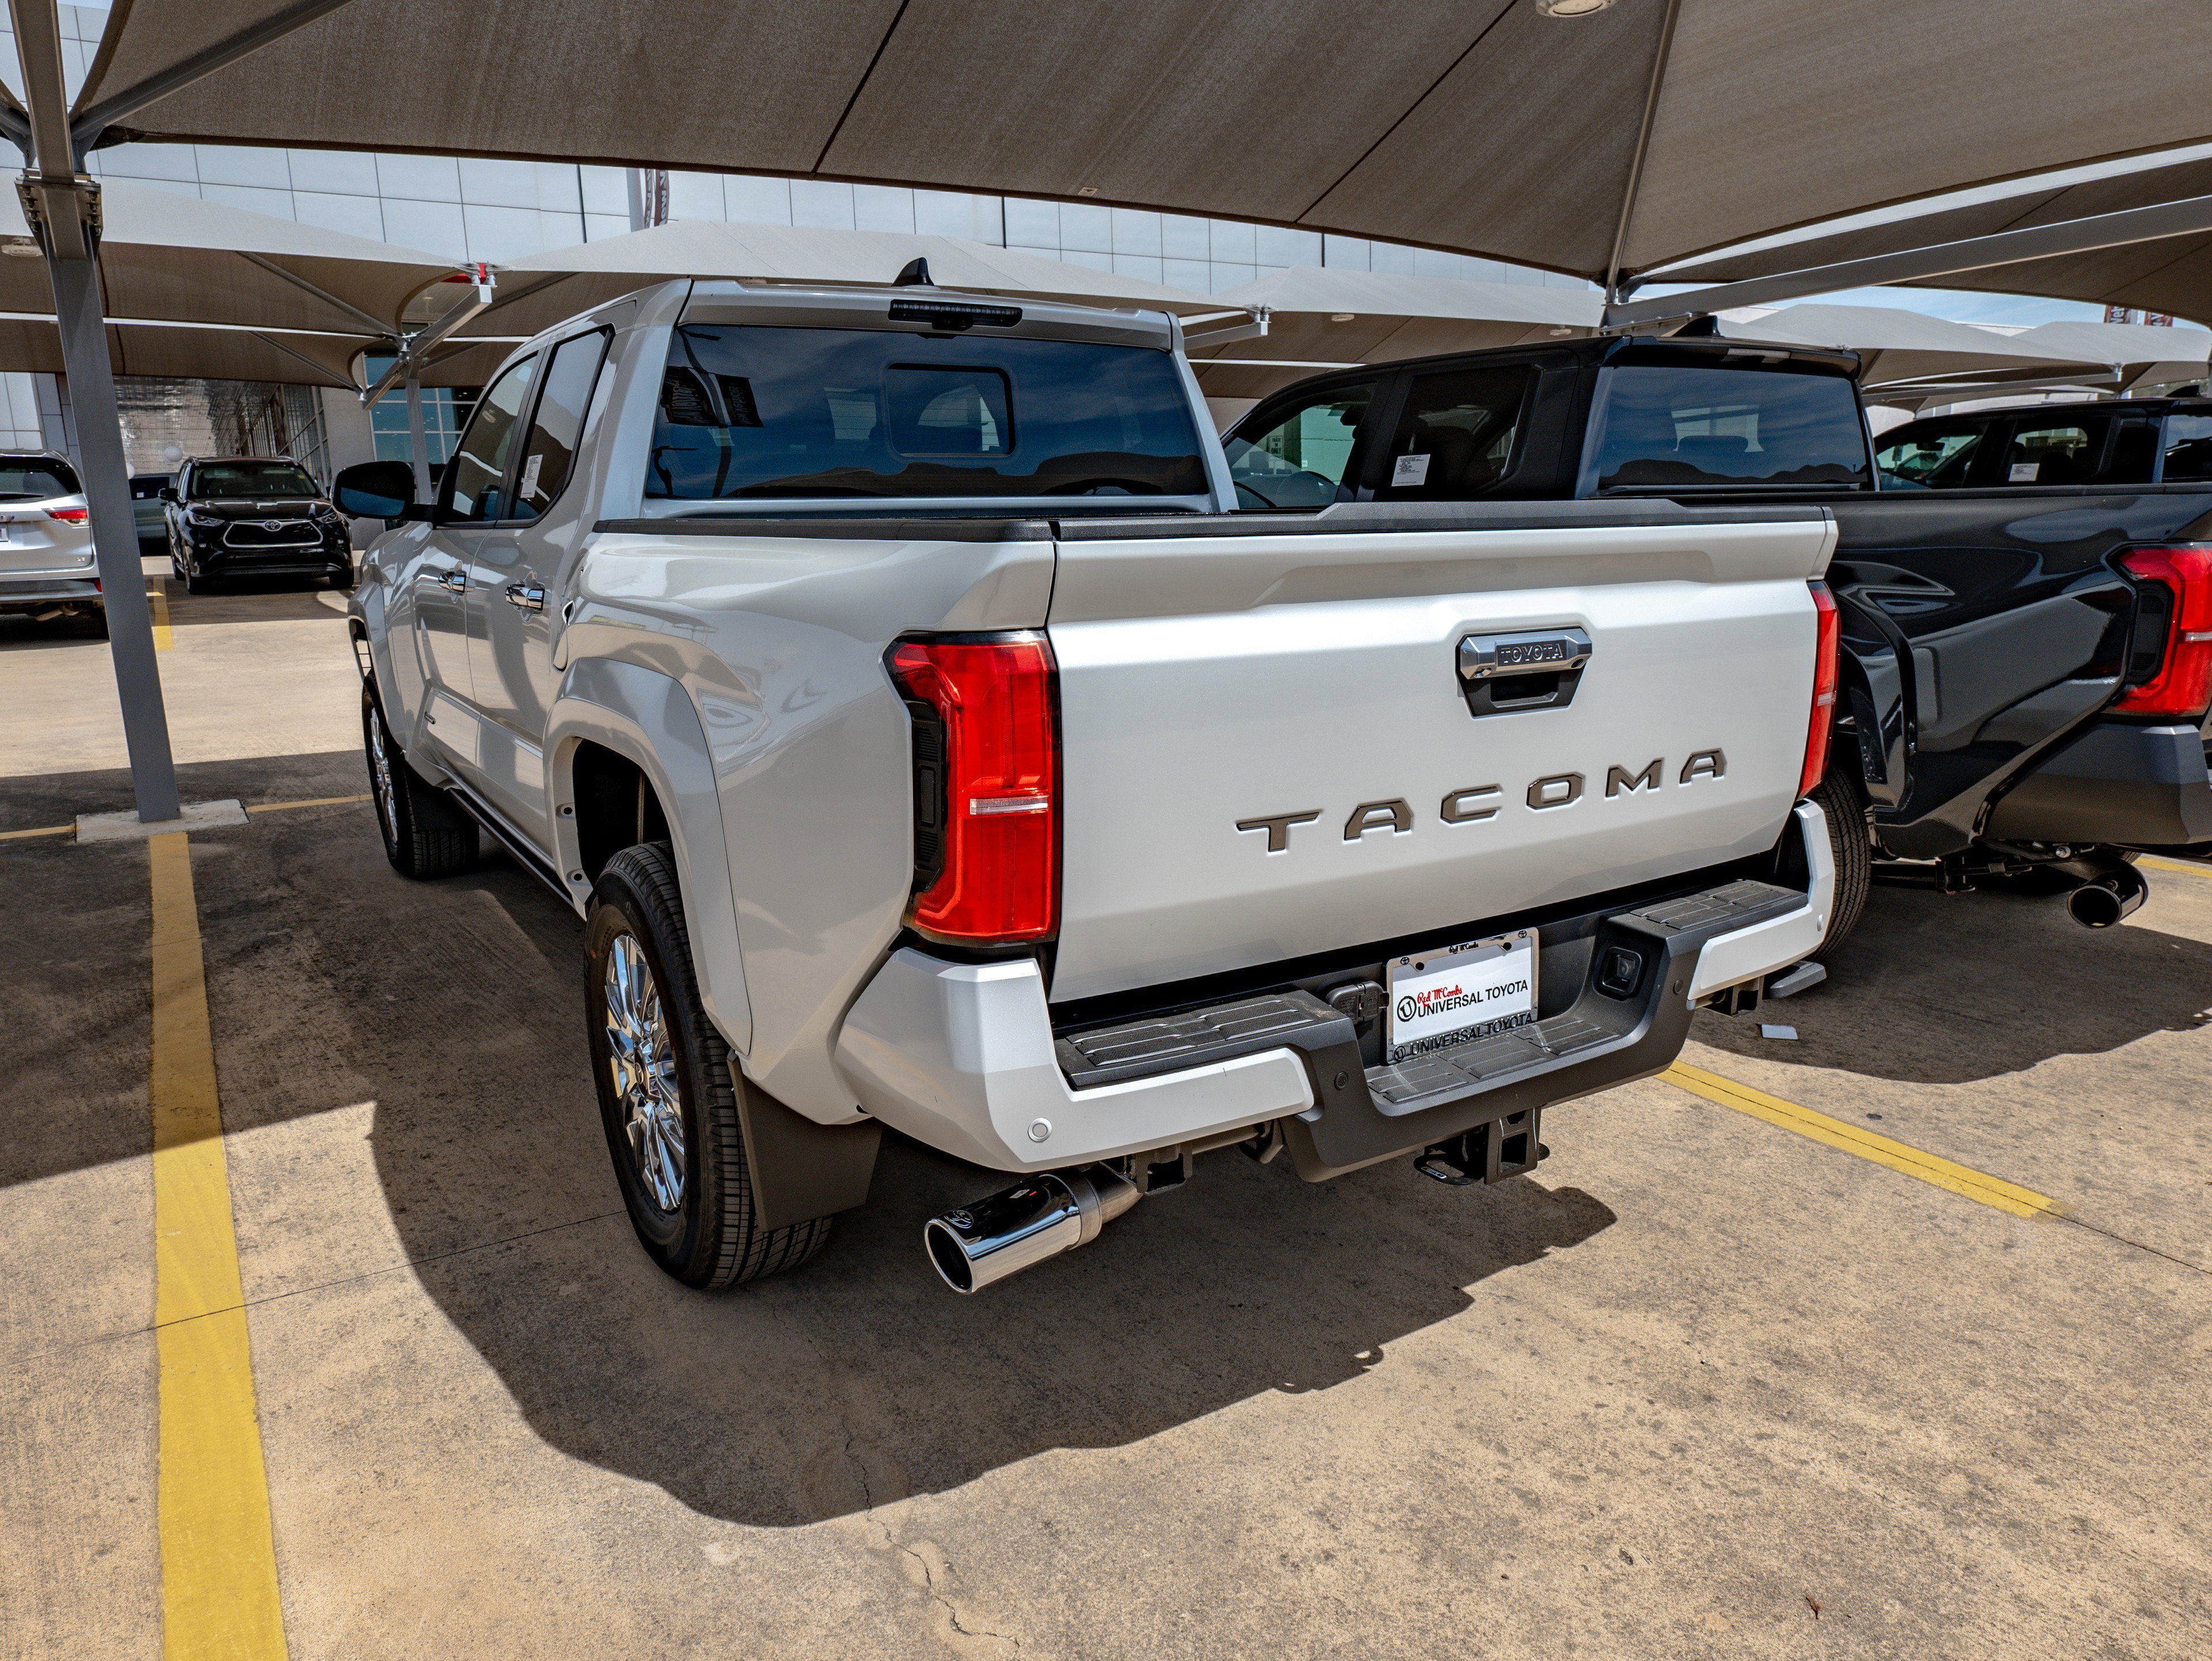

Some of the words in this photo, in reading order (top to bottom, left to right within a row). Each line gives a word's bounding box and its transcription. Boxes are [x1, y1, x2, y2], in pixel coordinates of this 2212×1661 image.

[1501, 643, 1563, 663] TOYOTA
[1236, 750, 1726, 853] TACOMA
[1399, 998, 1414, 1019] U
[1417, 991, 1431, 1007] Red
[1431, 985, 1463, 1000] McCombs
[1418, 991, 1484, 1018] UNIVERSAL
[1485, 979, 1528, 1000] TOYOTA
[1411, 1024, 1484, 1055] UNIVERSAL
[1485, 1012, 1532, 1035] TOYOTA
